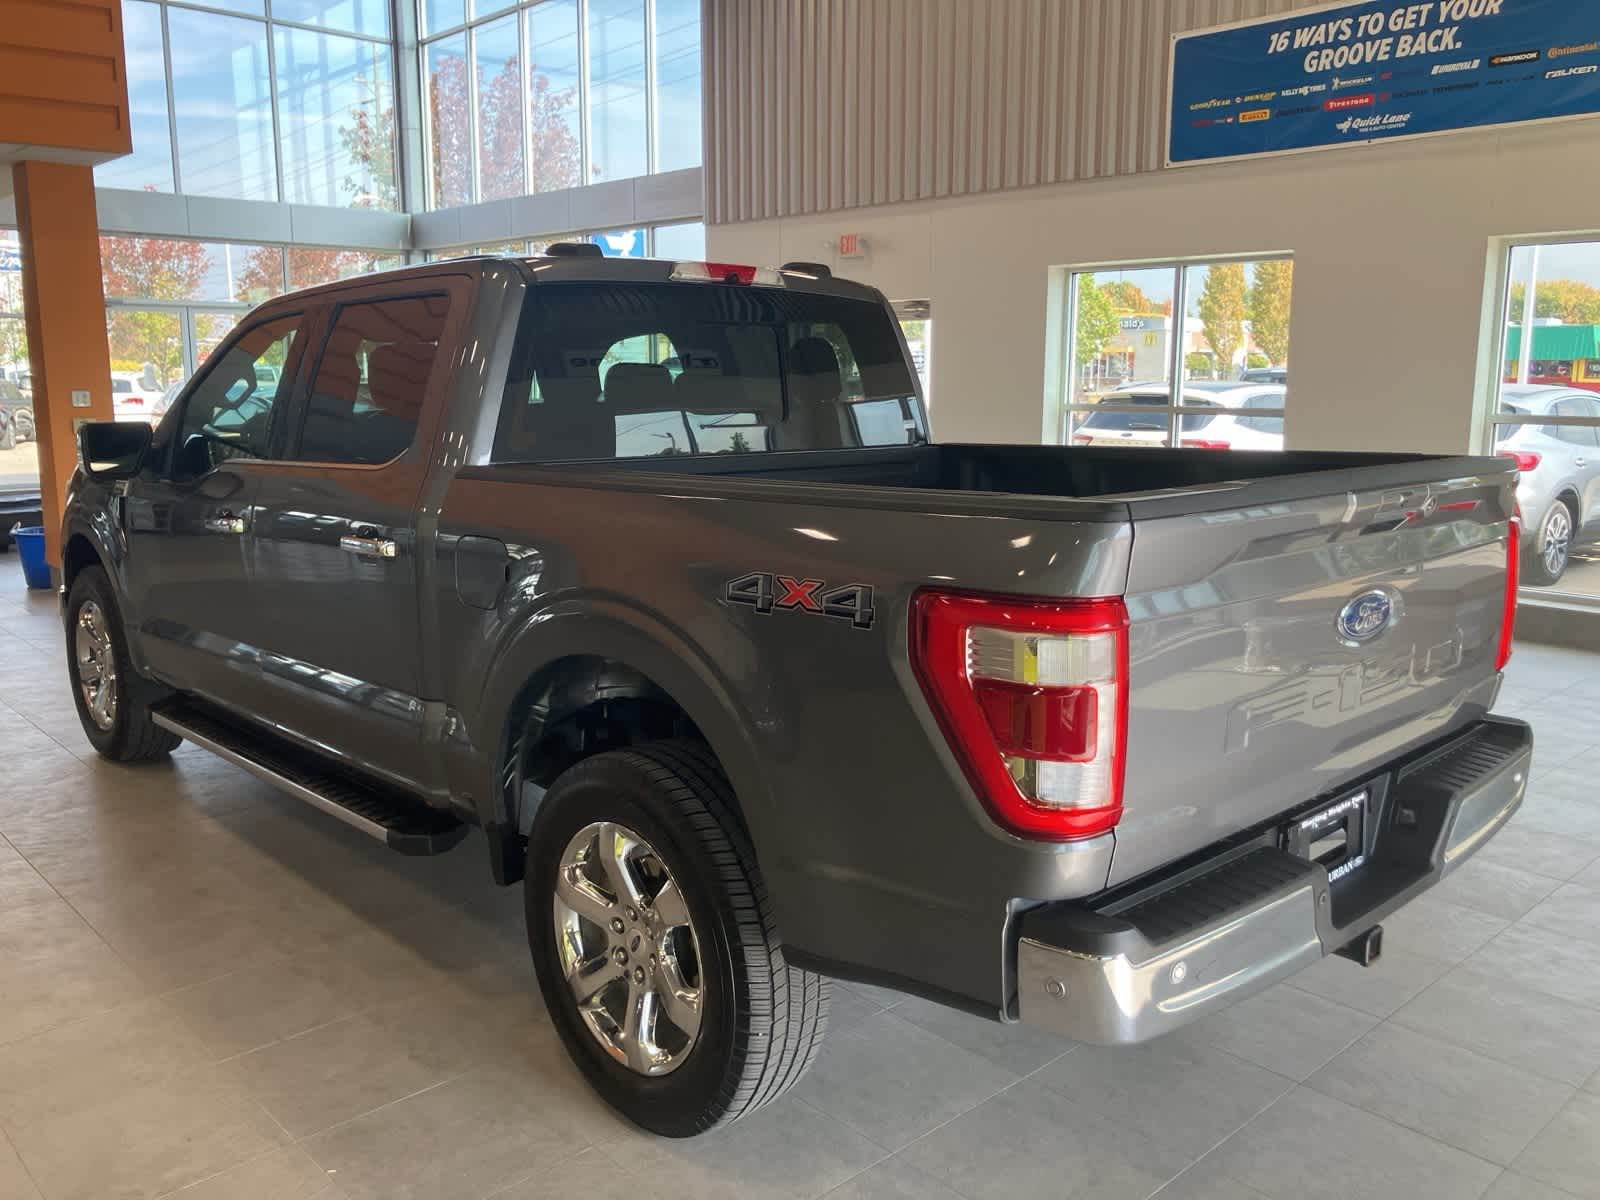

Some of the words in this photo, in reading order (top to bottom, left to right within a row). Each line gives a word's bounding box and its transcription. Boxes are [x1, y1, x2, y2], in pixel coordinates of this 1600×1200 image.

[1267, 31, 1291, 54] 16
[1293, 17, 1353, 49] WAYS
[1356, 12, 1385, 37] TO
[1388, 3, 1434, 31] GET
[1438, 0, 1501, 23] YOUR
[1303, 37, 1394, 73] GROOVE
[1395, 26, 1462, 58] BACK.
[1545, 65, 1598, 79] FALKEN
[1329, 98, 1370, 109] Firestone
[1352, 114, 1381, 129] Quick
[1381, 112, 1410, 124] Lane
[840, 234, 857, 255] EXIT
